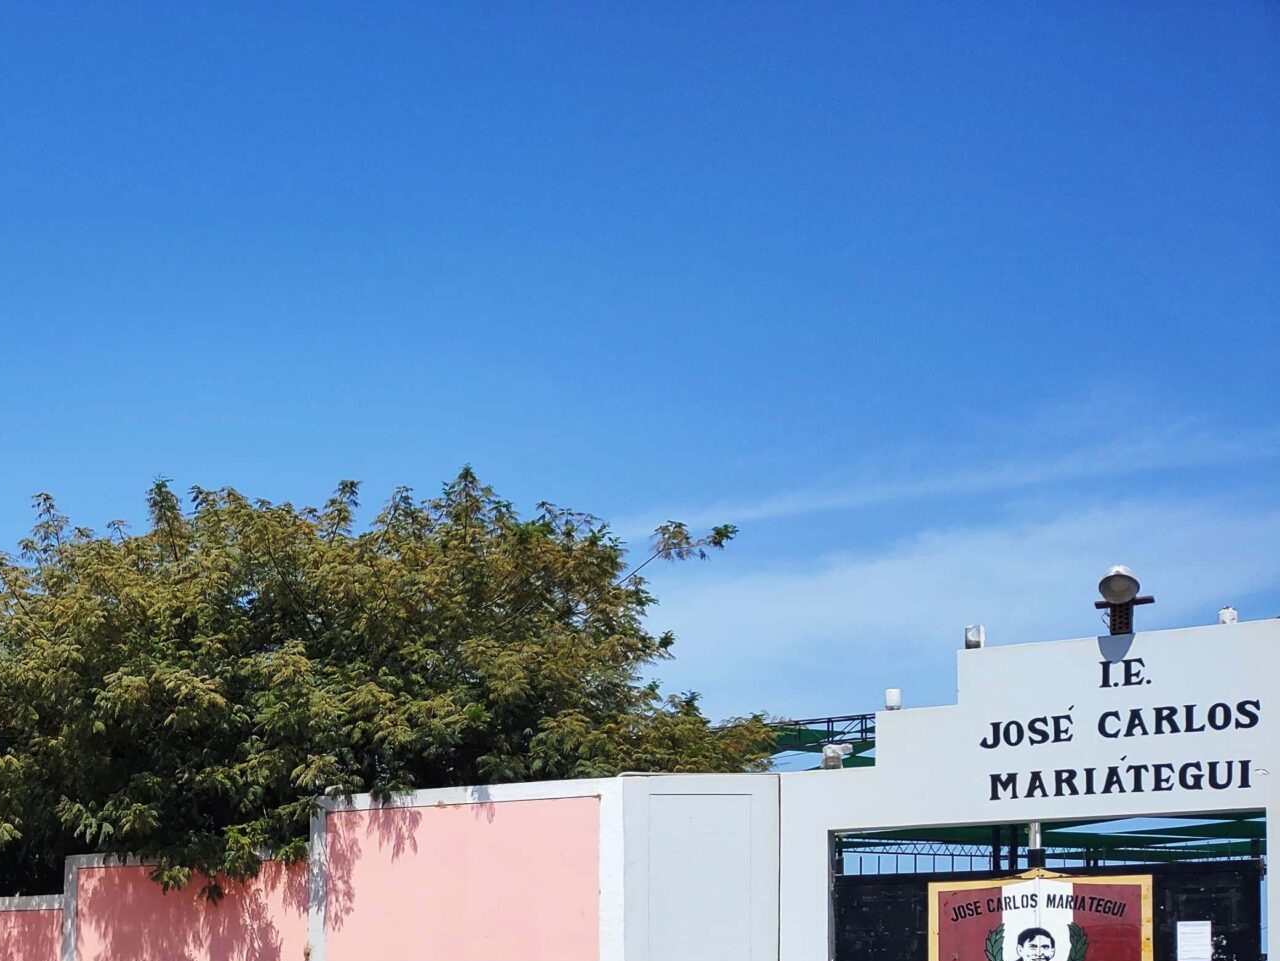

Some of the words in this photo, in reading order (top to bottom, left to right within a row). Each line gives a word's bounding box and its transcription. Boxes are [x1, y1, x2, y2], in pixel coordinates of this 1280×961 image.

[1098, 657, 1153, 688] I.E.
[979, 704, 1075, 749] JOSÉ
[1097, 699, 1261, 739] CARLOS
[989, 755, 1252, 801] MARIÁTEGUI
[950, 902, 982, 922] JOSE
[986, 893, 1039, 914] CARLOS
